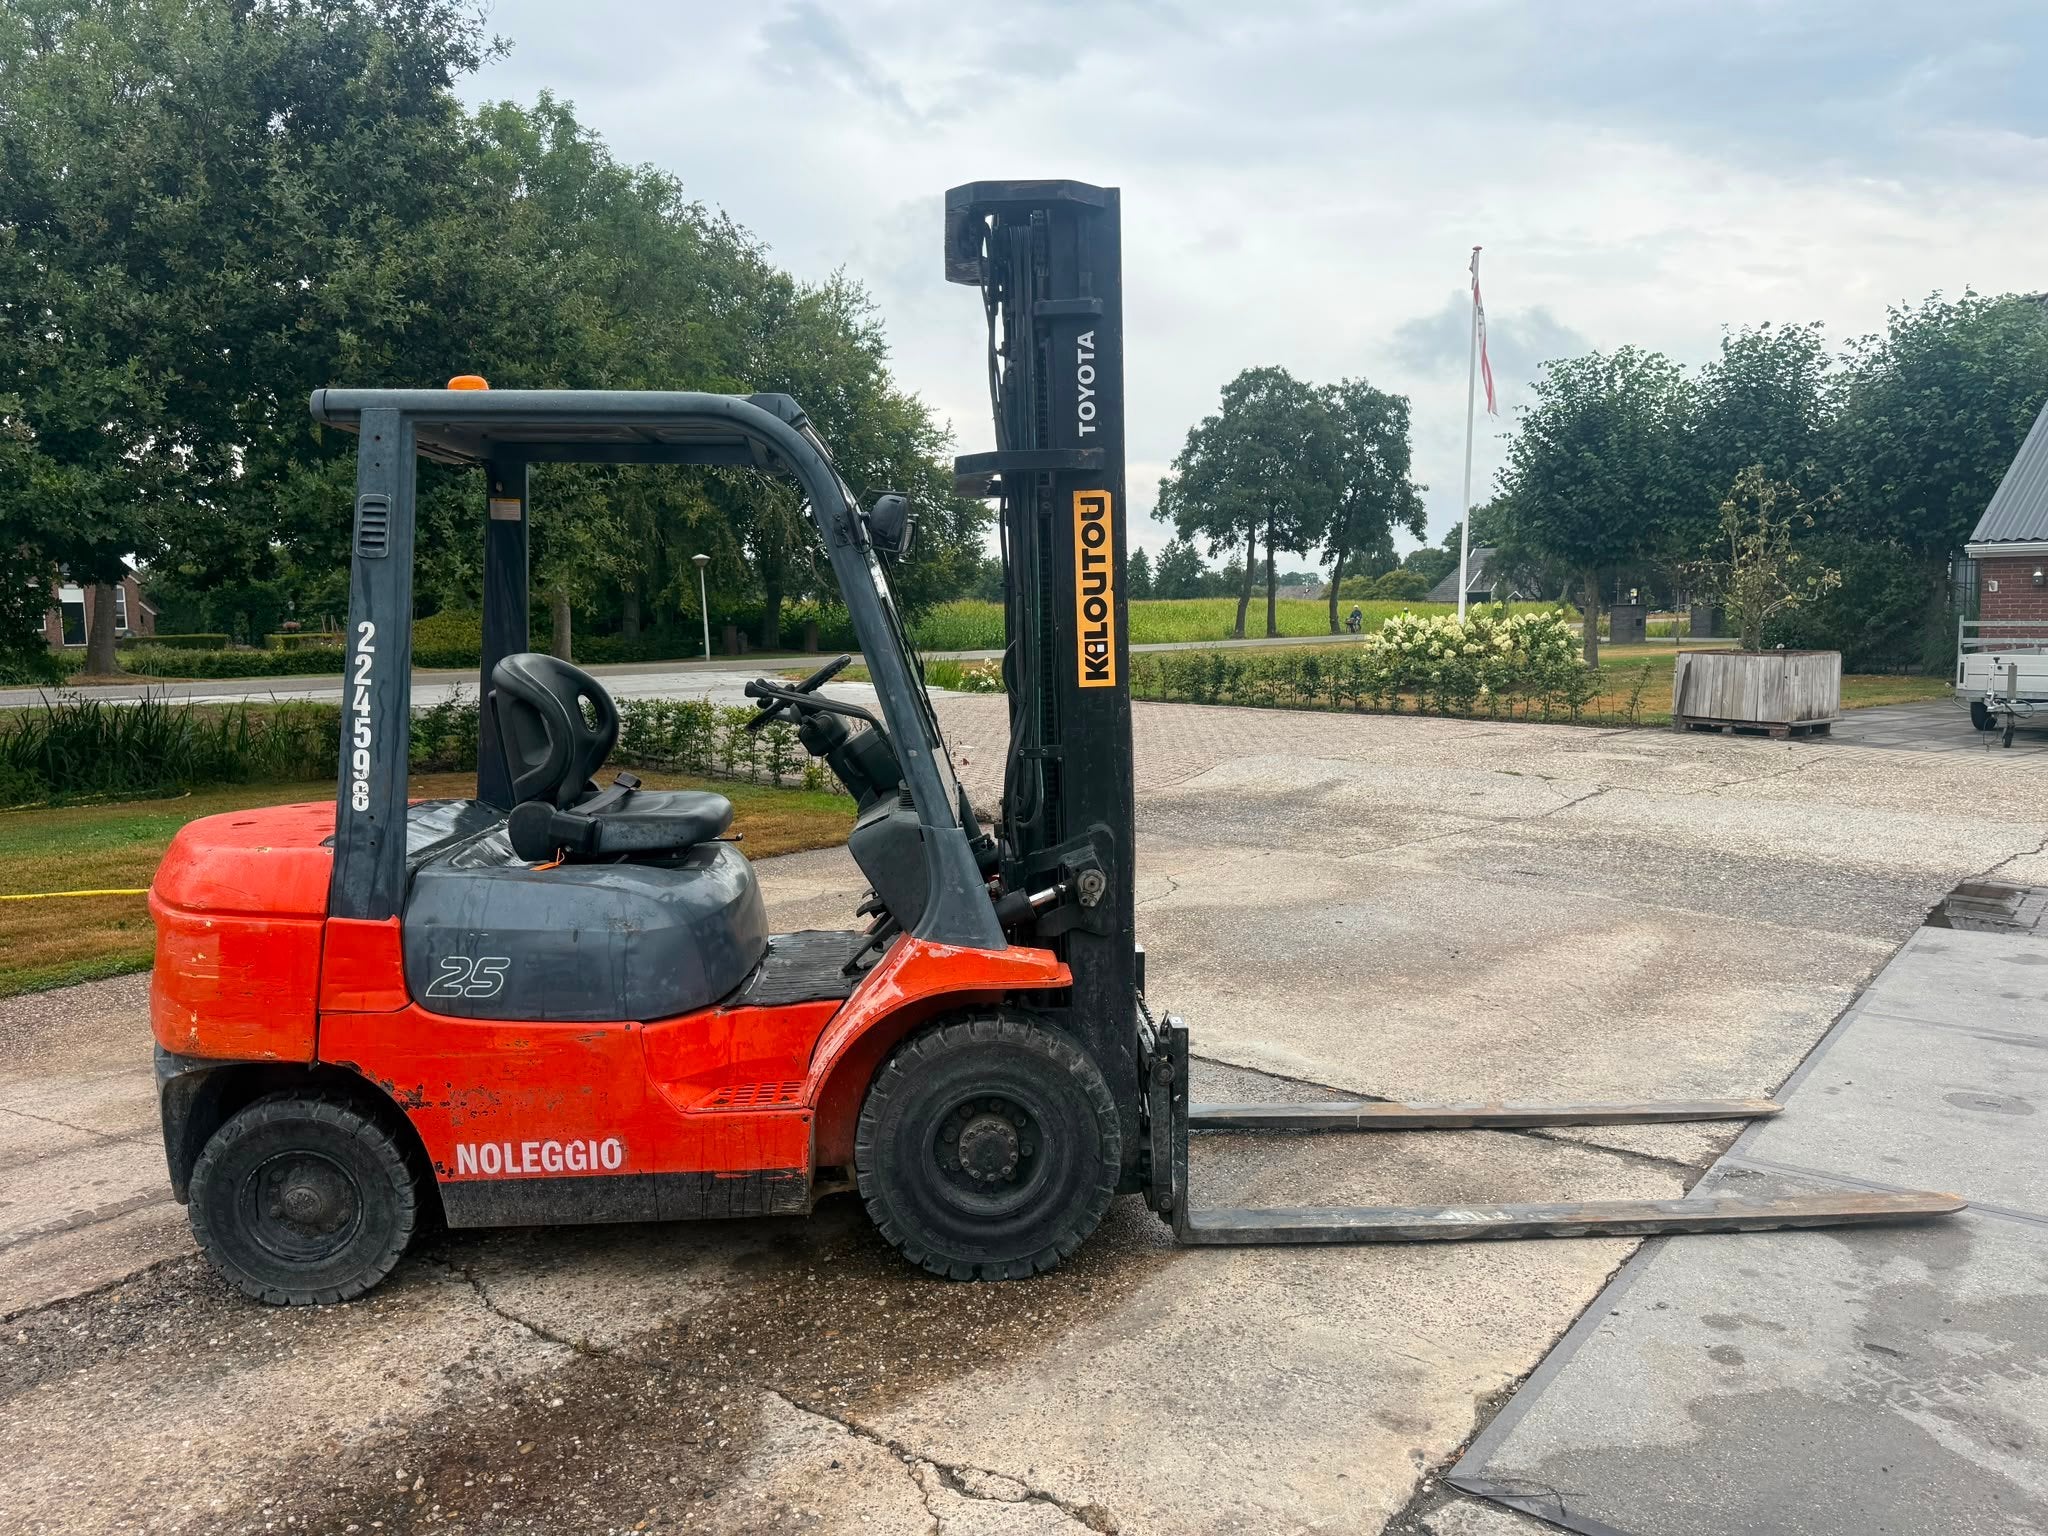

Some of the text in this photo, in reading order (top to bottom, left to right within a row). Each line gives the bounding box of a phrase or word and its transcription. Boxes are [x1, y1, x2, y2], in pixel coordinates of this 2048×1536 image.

[1077, 330, 1096, 437] TOYOTA
[351, 621, 376, 812] 224598
[425, 956, 511, 998] 25
[456, 1138, 623, 1175] NOLEGGIO
